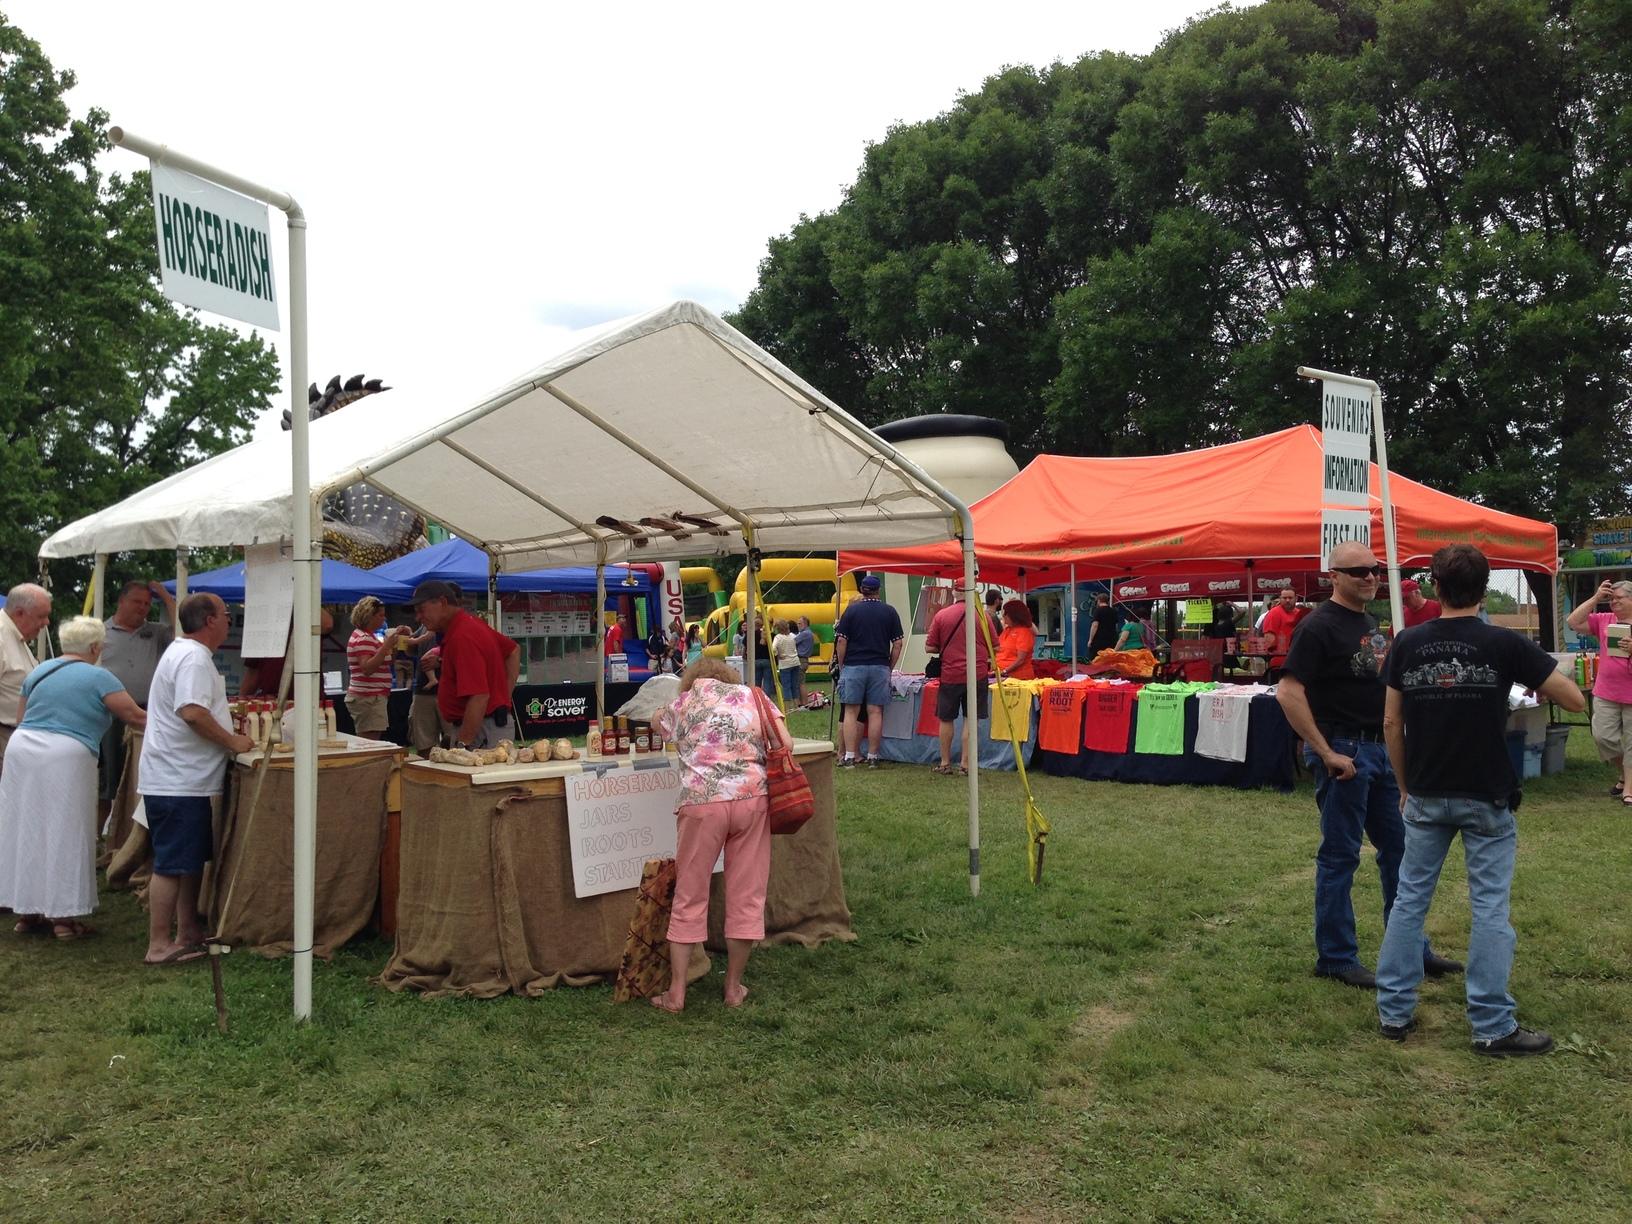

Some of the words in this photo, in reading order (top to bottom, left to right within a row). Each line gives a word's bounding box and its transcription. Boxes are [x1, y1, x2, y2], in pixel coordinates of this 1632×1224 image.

[159, 192, 273, 302] HORSERADISH
[1324, 393, 1370, 436] SOUVENIRS
[1324, 454, 1369, 495] INFORMATION
[1593, 531, 1625, 545] SHAVE
[1422, 645, 1469, 657] PANAMA
[558, 697, 586, 707] ENERGY
[580, 802, 632, 830] JARS
[581, 826, 654, 858] ROOTS
